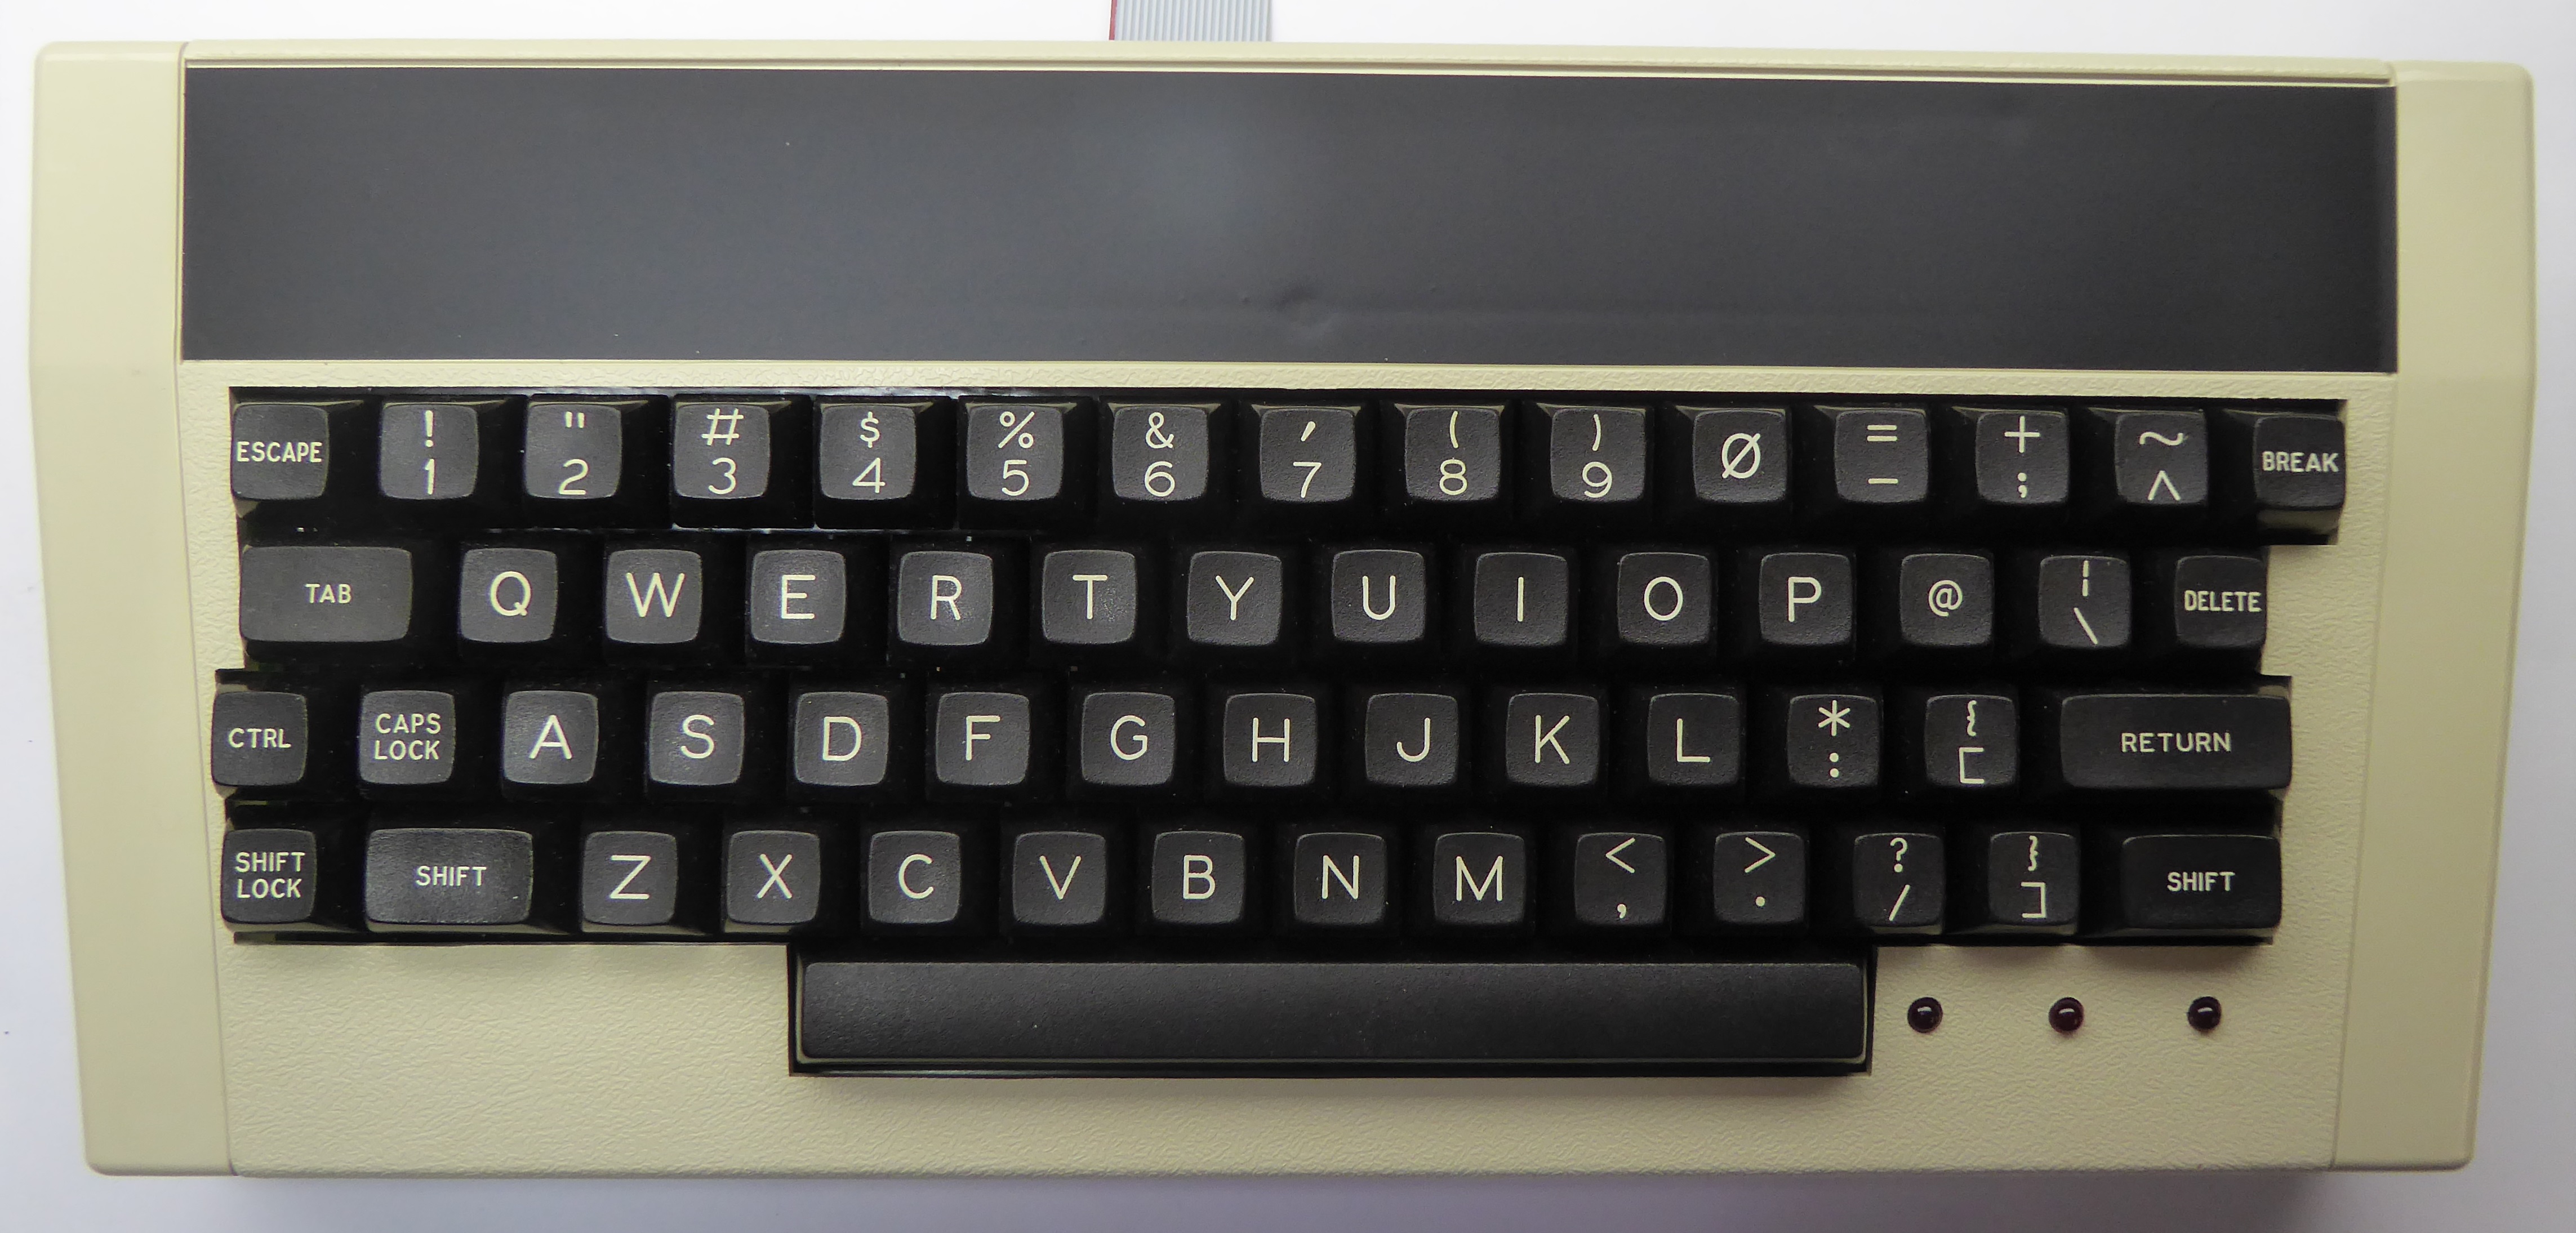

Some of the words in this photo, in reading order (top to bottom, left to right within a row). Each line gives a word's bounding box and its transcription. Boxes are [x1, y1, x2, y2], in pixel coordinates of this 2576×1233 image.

[424, 410, 434, 447] !
[701, 408, 744, 446] #
[860, 411, 880, 448] $
[998, 411, 1035, 448] %
[1145, 412, 1174, 449] &
[1448, 409, 1460, 449] (
[1592, 413, 1601, 451] )
[1867, 425, 1898, 442] =
[2004, 415, 2040, 453] +
[2139, 431, 2184, 446] ~
[237, 441, 322, 463] ESCAPE
[2262, 451, 2339, 473] BREAK
[424, 459, 435, 495] 1
[558, 459, 588, 495] 2
[708, 457, 736, 495] 3
[852, 457, 886, 493] 4
[1002, 459, 1029, 496] 5
[1144, 461, 1175, 497] 6
[1293, 461, 1322, 498] 7
[1439, 459, 1468, 496] 8
[1582, 461, 1613, 498] 9
[2017, 472, 2028, 498] ;
[305, 584, 352, 604] TAB
[490, 571, 531, 616] Q
[626, 572, 685, 617] W
[781, 574, 816, 620] E
[930, 575, 962, 621] R
[1072, 575, 1108, 620] T
[1215, 575, 1254, 621] Y
[1362, 575, 1396, 621] U
[1517, 577, 1524, 622] I
[1644, 576, 1683, 621] O
[1788, 576, 1822, 622] P
[1928, 580, 1963, 617] @
[2184, 590, 2262, 612] DELETE
[2074, 607, 2098, 644] \
[228, 728, 291, 749] CTRL
[376, 713, 441, 734] CAPS
[528, 715, 572, 759] A
[680, 714, 714, 759] S
[822, 716, 862, 762] D
[966, 715, 1000, 761] F
[1110, 715, 1148, 760] G
[1252, 717, 1290, 762] H
[1396, 717, 1431, 762] J
[1534, 715, 1570, 764] K
[1676, 718, 1711, 763] L
[374, 740, 440, 760] LOCK
[2121, 732, 2231, 753] RETURN
[1829, 753, 1839, 778] :
[1959, 747, 1985, 785] [
[235, 852, 305, 873] SHIFT
[1605, 837, 1635, 874] <
[1744, 836, 1776, 873] >
[1890, 837, 1908, 873] ?
[237, 878, 302, 898] LOCK
[416, 865, 487, 887] SHIFT
[609, 854, 651, 900] Z
[757, 853, 793, 899] X
[898, 854, 934, 899] C
[1039, 855, 1082, 900] V
[1182, 854, 1216, 900] B
[1322, 855, 1359, 900] N
[1456, 856, 1503, 901] M
[2167, 871, 2235, 892] SHIFT
[1617, 903, 1627, 919] ,
[1755, 896, 1765, 907] .
[1888, 884, 1910, 922] /
[2021, 882, 2046, 919] ]
